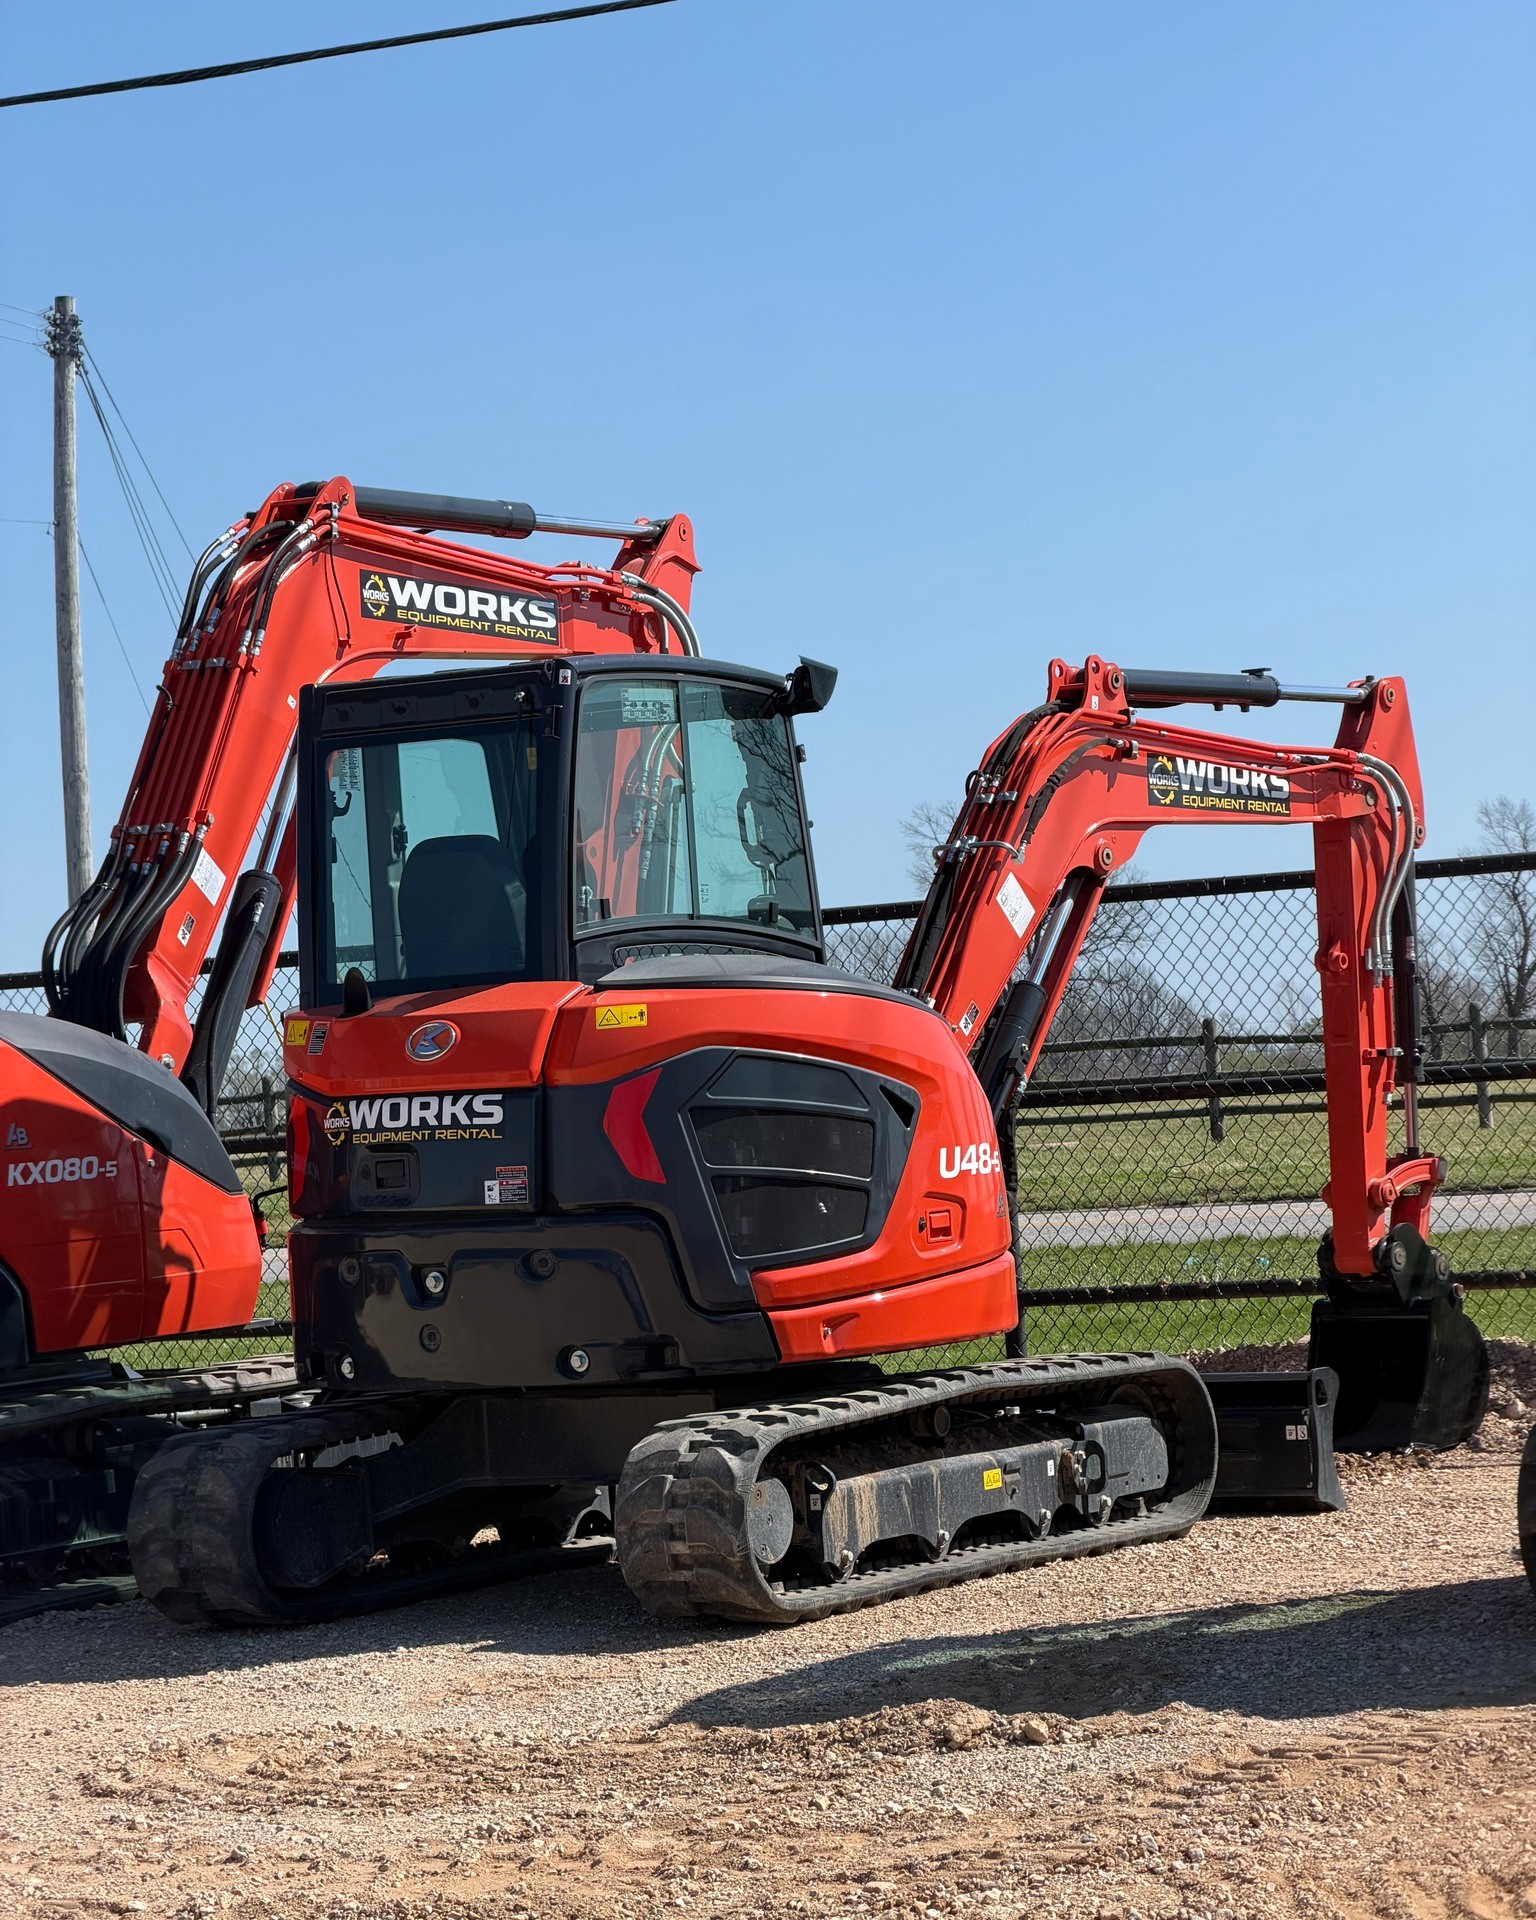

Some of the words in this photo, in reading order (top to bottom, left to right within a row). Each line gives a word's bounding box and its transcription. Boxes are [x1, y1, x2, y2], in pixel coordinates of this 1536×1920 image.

[362, 588, 390, 602] WORKS
[387, 576, 557, 629] WORKS
[396, 609, 491, 631] EQUIPMENT
[495, 624, 557, 641] RENTAL
[1148, 773, 1180, 787] WORKS
[1175, 756, 1290, 799] WORKS
[1182, 794, 1245, 809] EQUIPMENT
[1247, 800, 1290, 814] RENTAL
[323, 1116, 350, 1129] WORKS
[349, 1093, 504, 1130] WORKS
[352, 1130, 432, 1144] EQUIPMENT
[435, 1128, 503, 1140] RENTAL
[7, 1155, 118, 1187] KX080-5
[939, 1142, 1001, 1179] U48-5
